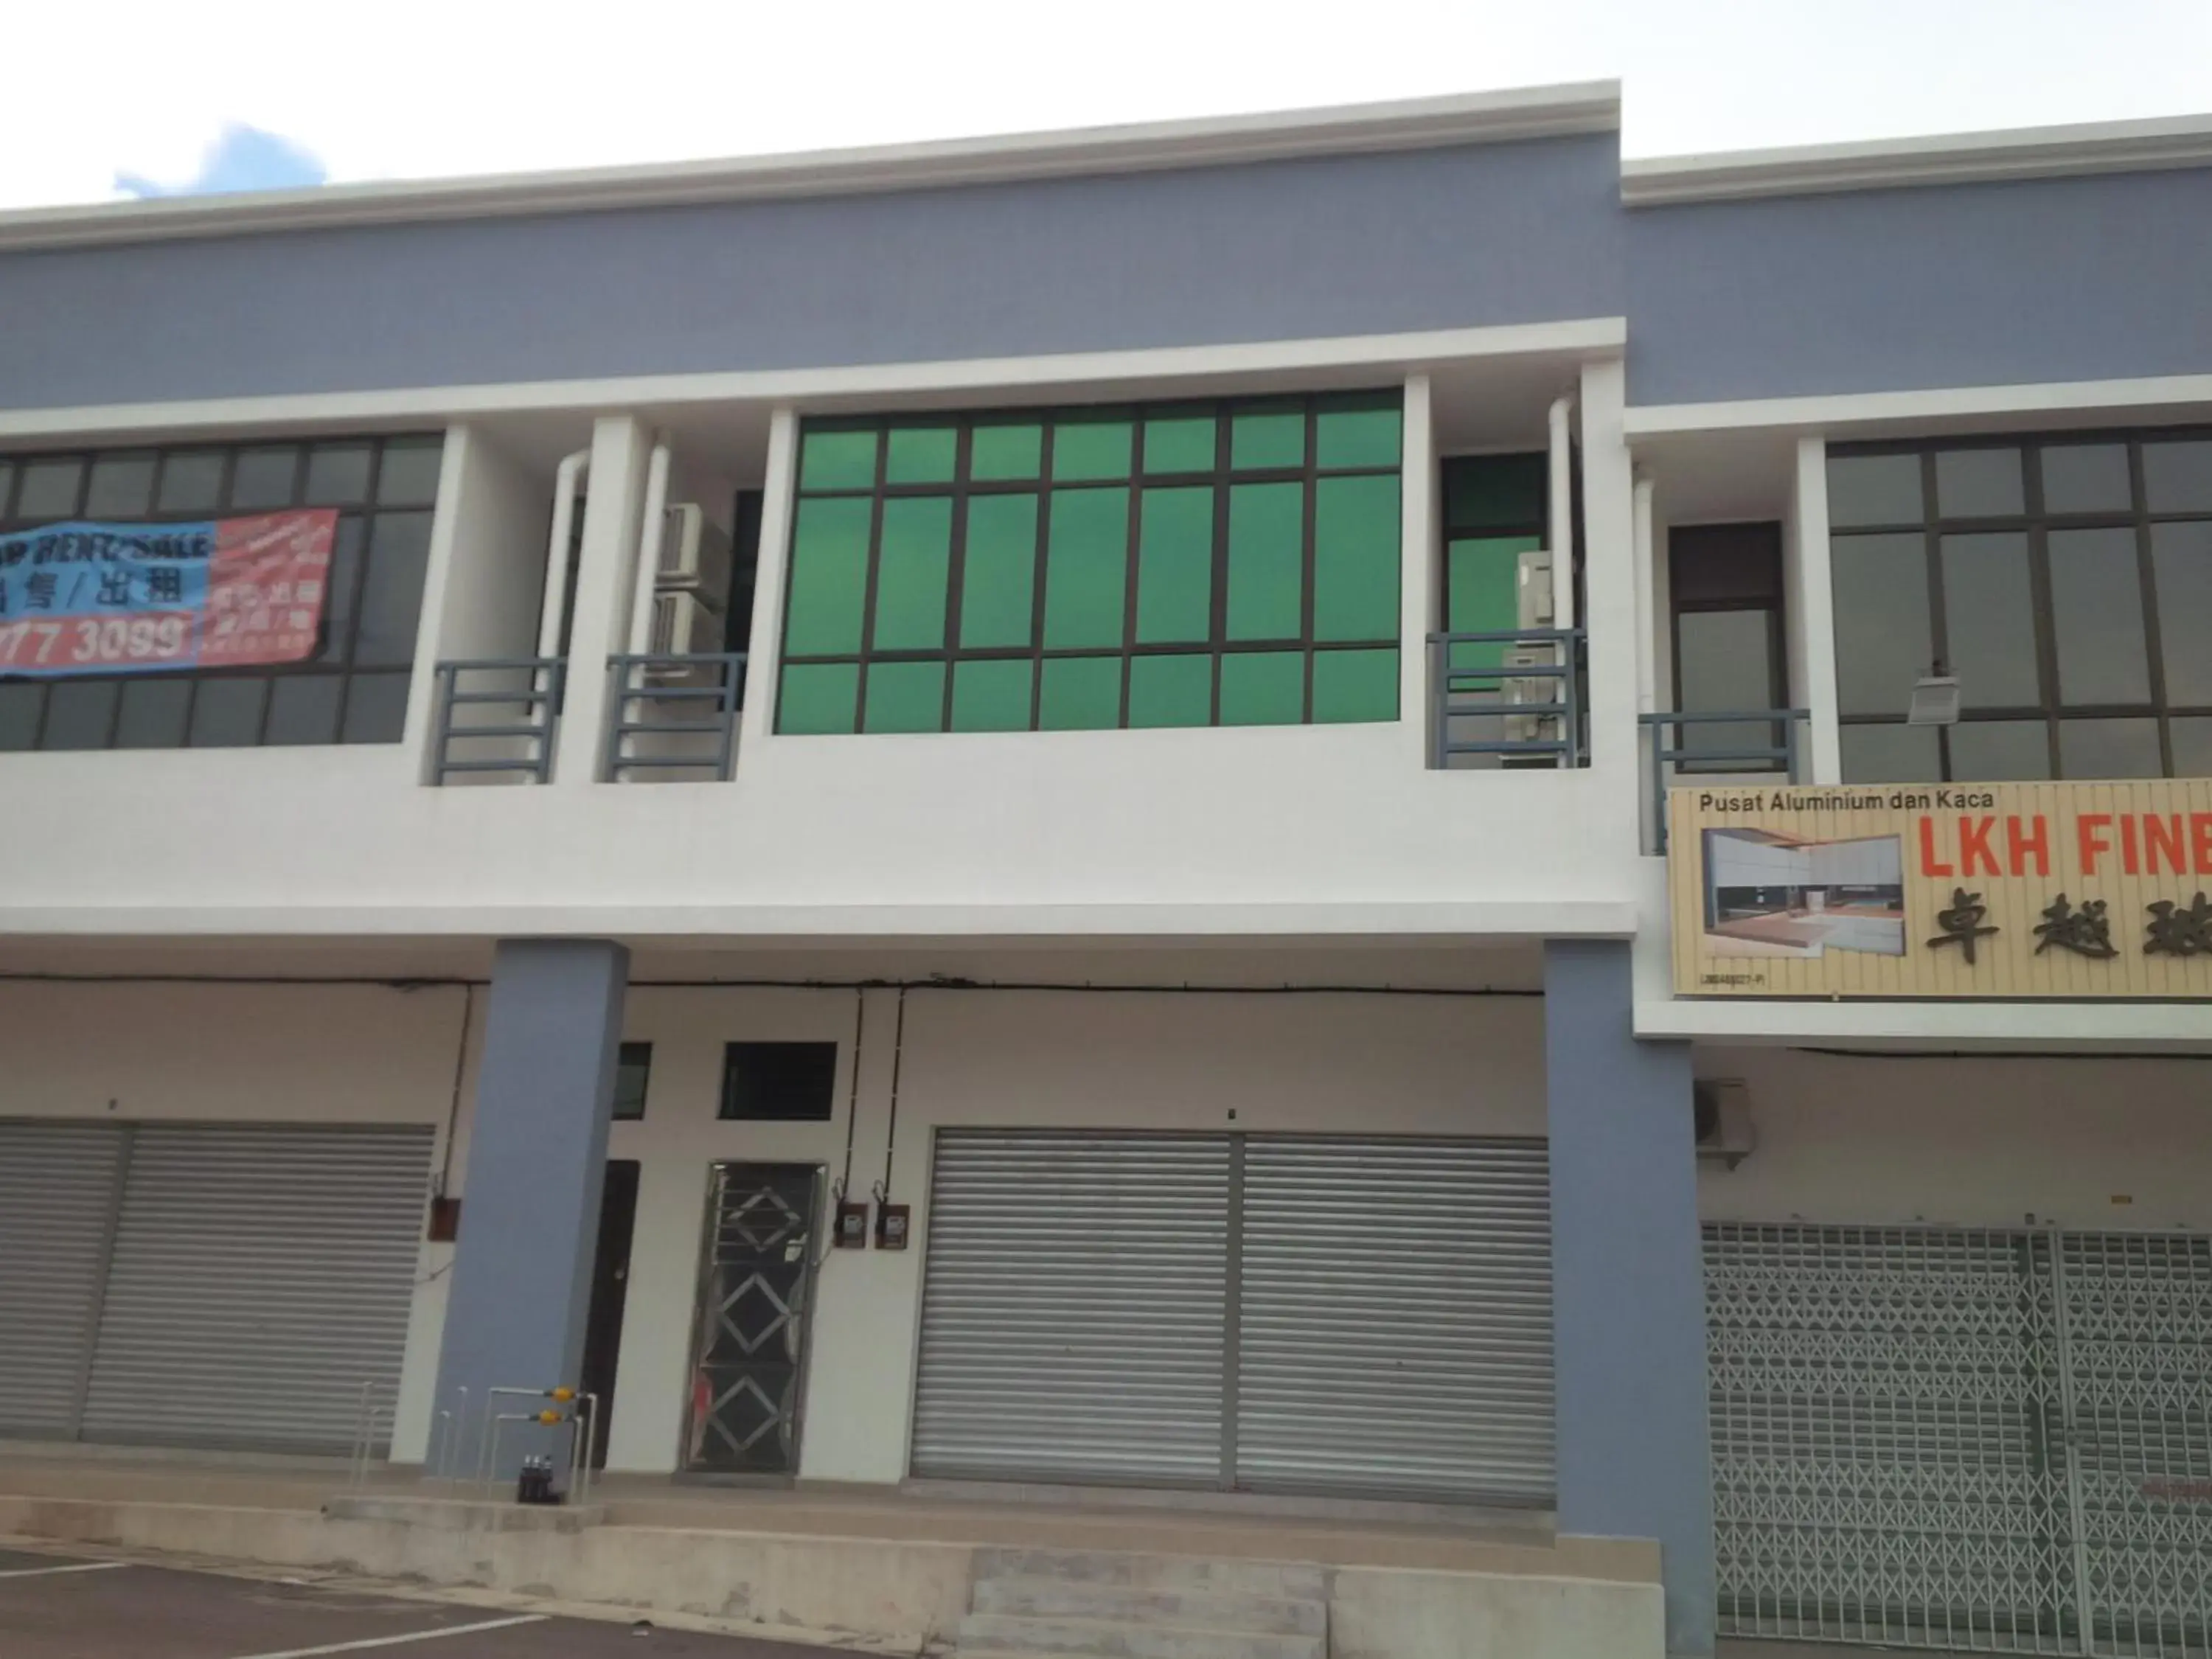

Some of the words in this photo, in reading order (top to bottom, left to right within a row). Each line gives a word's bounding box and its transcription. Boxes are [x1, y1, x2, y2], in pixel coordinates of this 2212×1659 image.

[72, 616, 184, 661] 3099
[1700, 793, 1764, 812] Pusat
[1770, 791, 1883, 811] Aluminium
[1889, 790, 1930, 810] dan
[1935, 790, 1994, 809] Kaca
[1919, 814, 2051, 877] LKH
